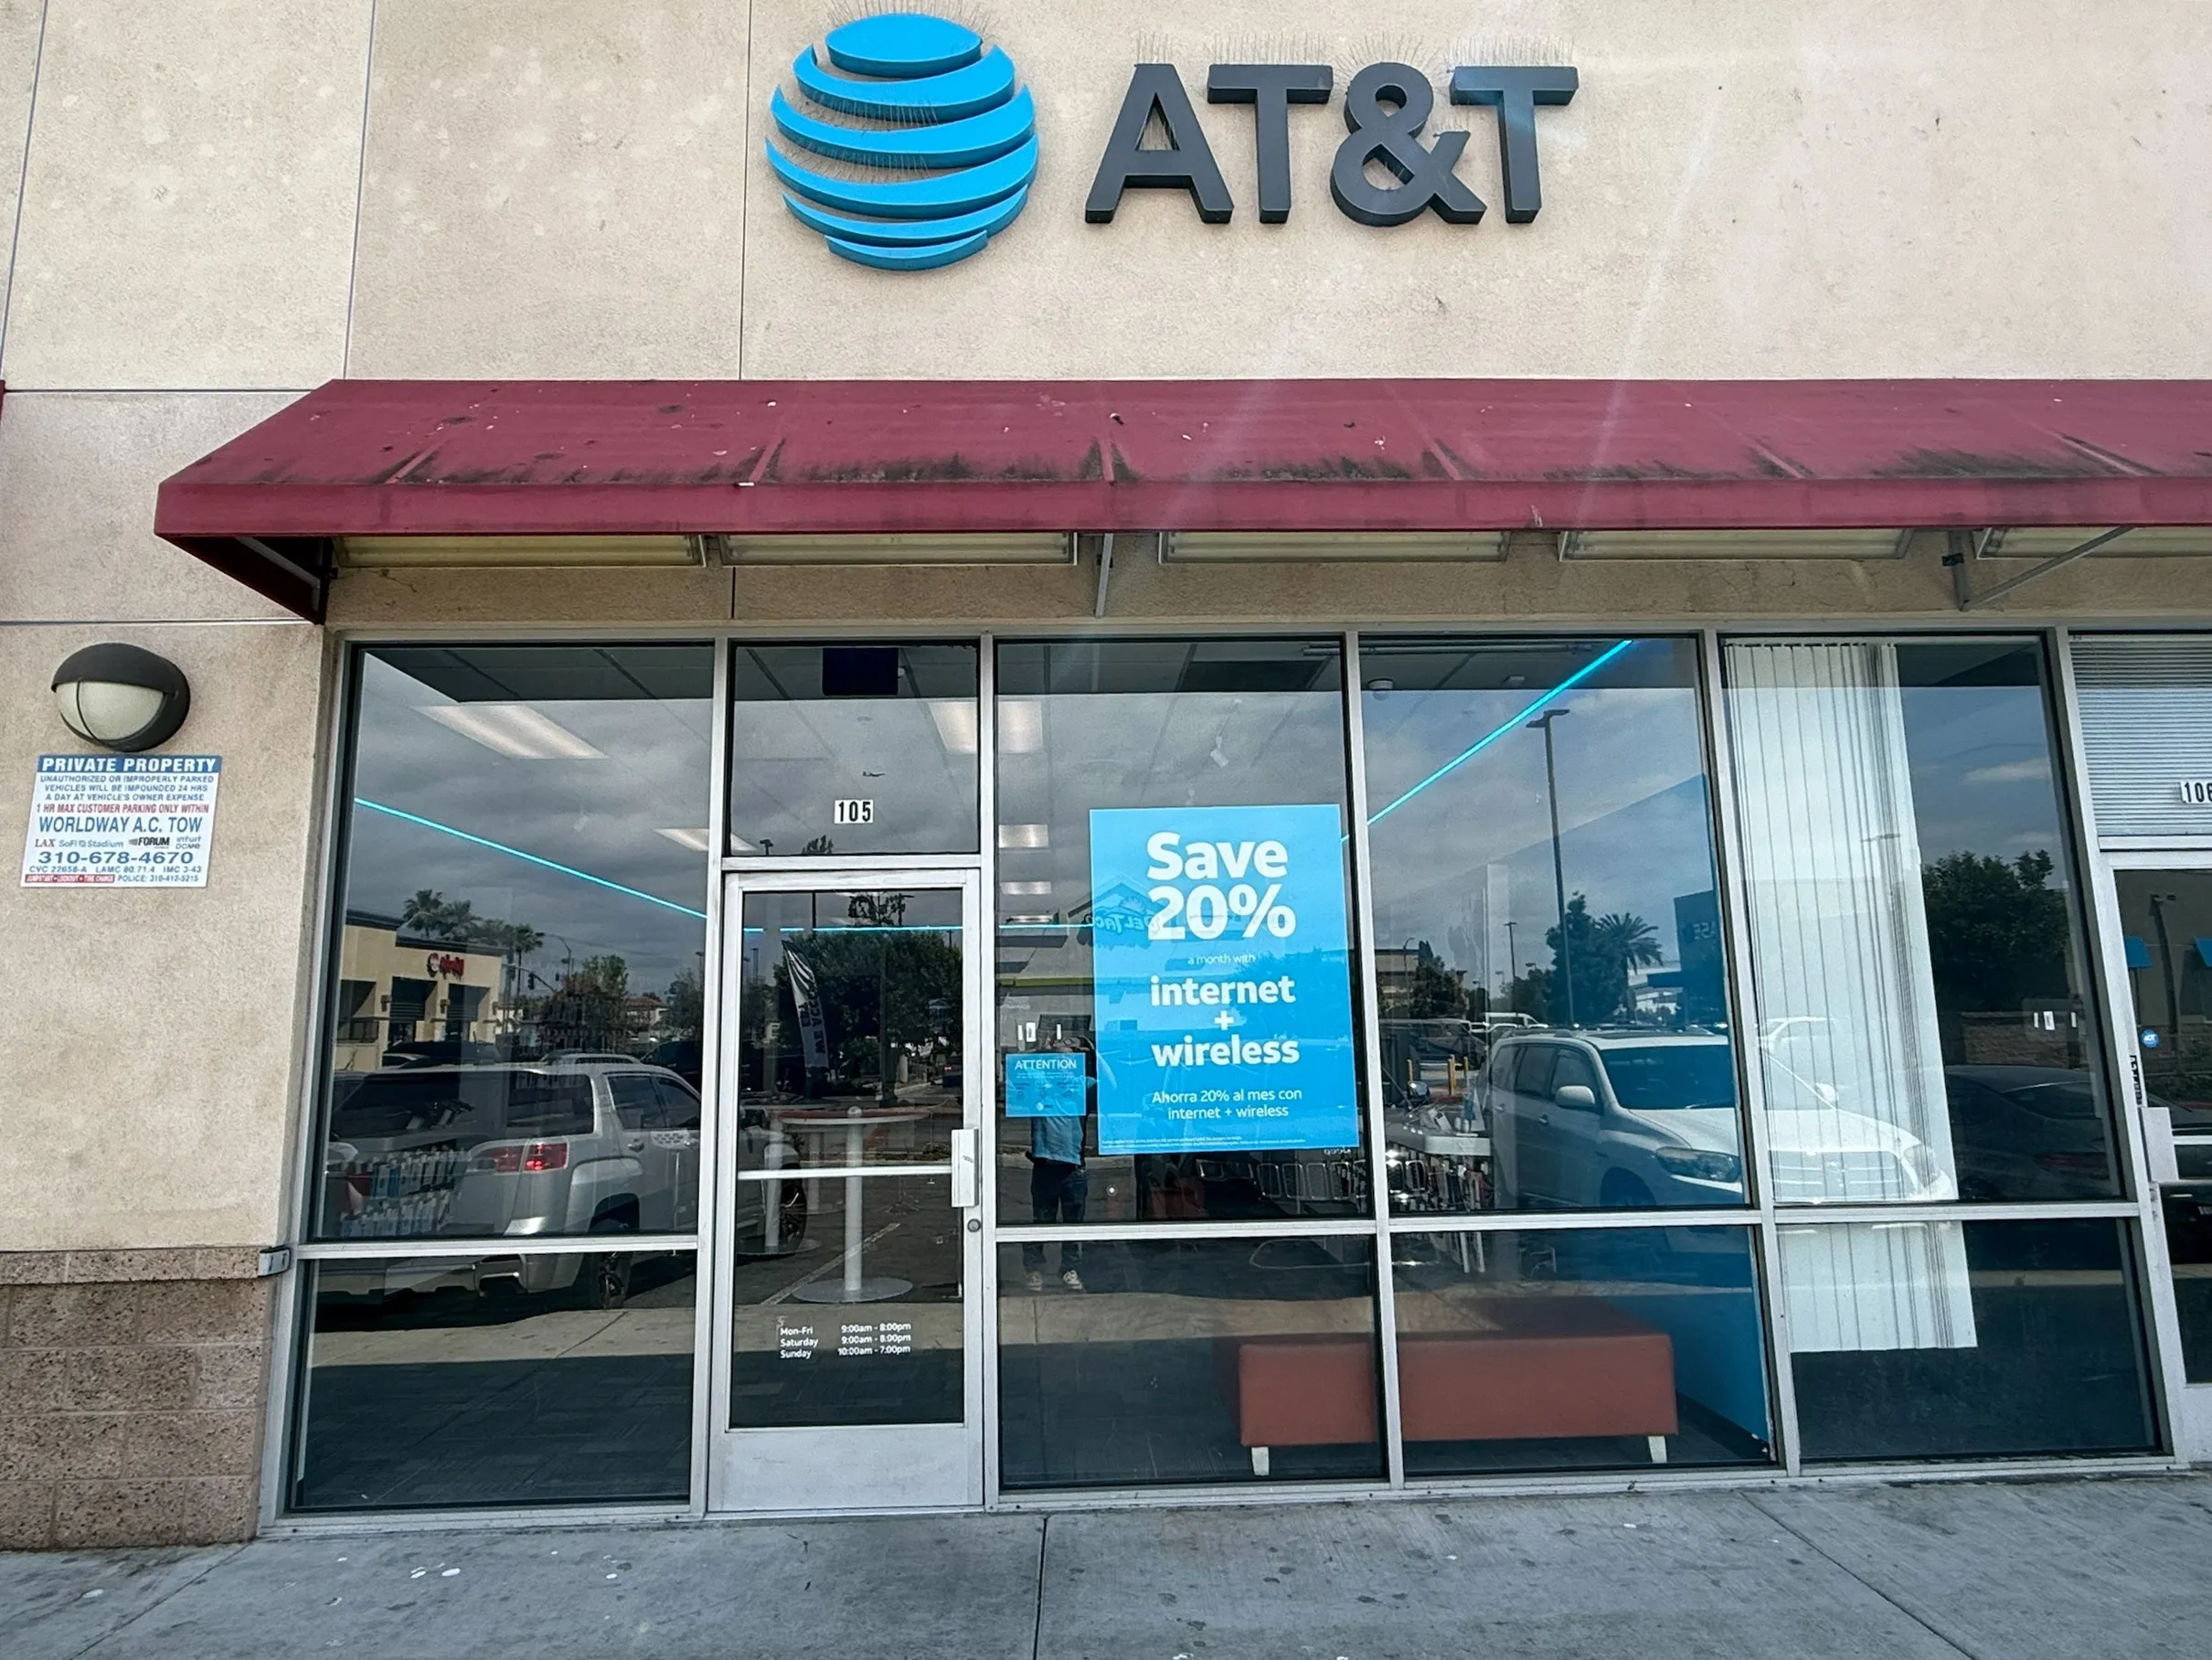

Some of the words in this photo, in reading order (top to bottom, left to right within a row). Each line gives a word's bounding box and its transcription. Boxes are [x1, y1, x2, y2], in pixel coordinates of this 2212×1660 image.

[1085, 62, 1579, 227] AT&T
[42, 758, 117, 771] PRIVATE
[123, 759, 217, 771] PROPERTY
[37, 803, 40, 813] 1
[43, 803, 55, 813] HR
[57, 803, 75, 813] MAX
[77, 803, 120, 813] CUSTOMER
[122, 804, 156, 813] PARKING
[159, 804, 179, 813] ONLY
[181, 804, 209, 813] WITHIN
[838, 801, 871, 822] 105
[39, 816, 130, 832] WORLDWAY
[133, 817, 162, 833] A.C.
[168, 817, 203, 833] TOW
[35, 839, 55, 847] LAX
[138, 837, 170, 846] FORUM
[38, 852, 193, 864] 310-678-4670
[1146, 832, 1288, 880] Save
[1147, 884, 1296, 941] 20%
[1187, 955, 1194, 964] a
[1196, 953, 1230, 964] month
[1233, 952, 1256, 963] with
[1151, 975, 1296, 1006] internet
[1215, 1011, 1235, 1031] +
[1152, 1035, 1301, 1068] wireless
[1015, 1059, 1077, 1070] ATTENTION
[1152, 1090, 1197, 1103] Ahorra
[1200, 1090, 1229, 1102] 20%
[1233, 1089, 1244, 1101] al
[1248, 1092, 1276, 1101] mes
[1279, 1090, 1303, 1100] con
[1167, 1105, 1221, 1120] internet
[1224, 1109, 1233, 1117] +
[1236, 1104, 1289, 1118] wireless
[780, 1326, 814, 1335] Mon-Fri
[841, 1324, 872, 1333] 9:00am
[879, 1323, 911, 1332] 8:00pm
[780, 1337, 818, 1347] Saturday
[841, 1335, 872, 1345] 9:00am
[879, 1334, 911, 1344] 8:00pm
[780, 1349, 812, 1359] Sunday
[838, 1347, 872, 1356] 10:00am
[880, 1346, 910, 1355] 7:00pm
